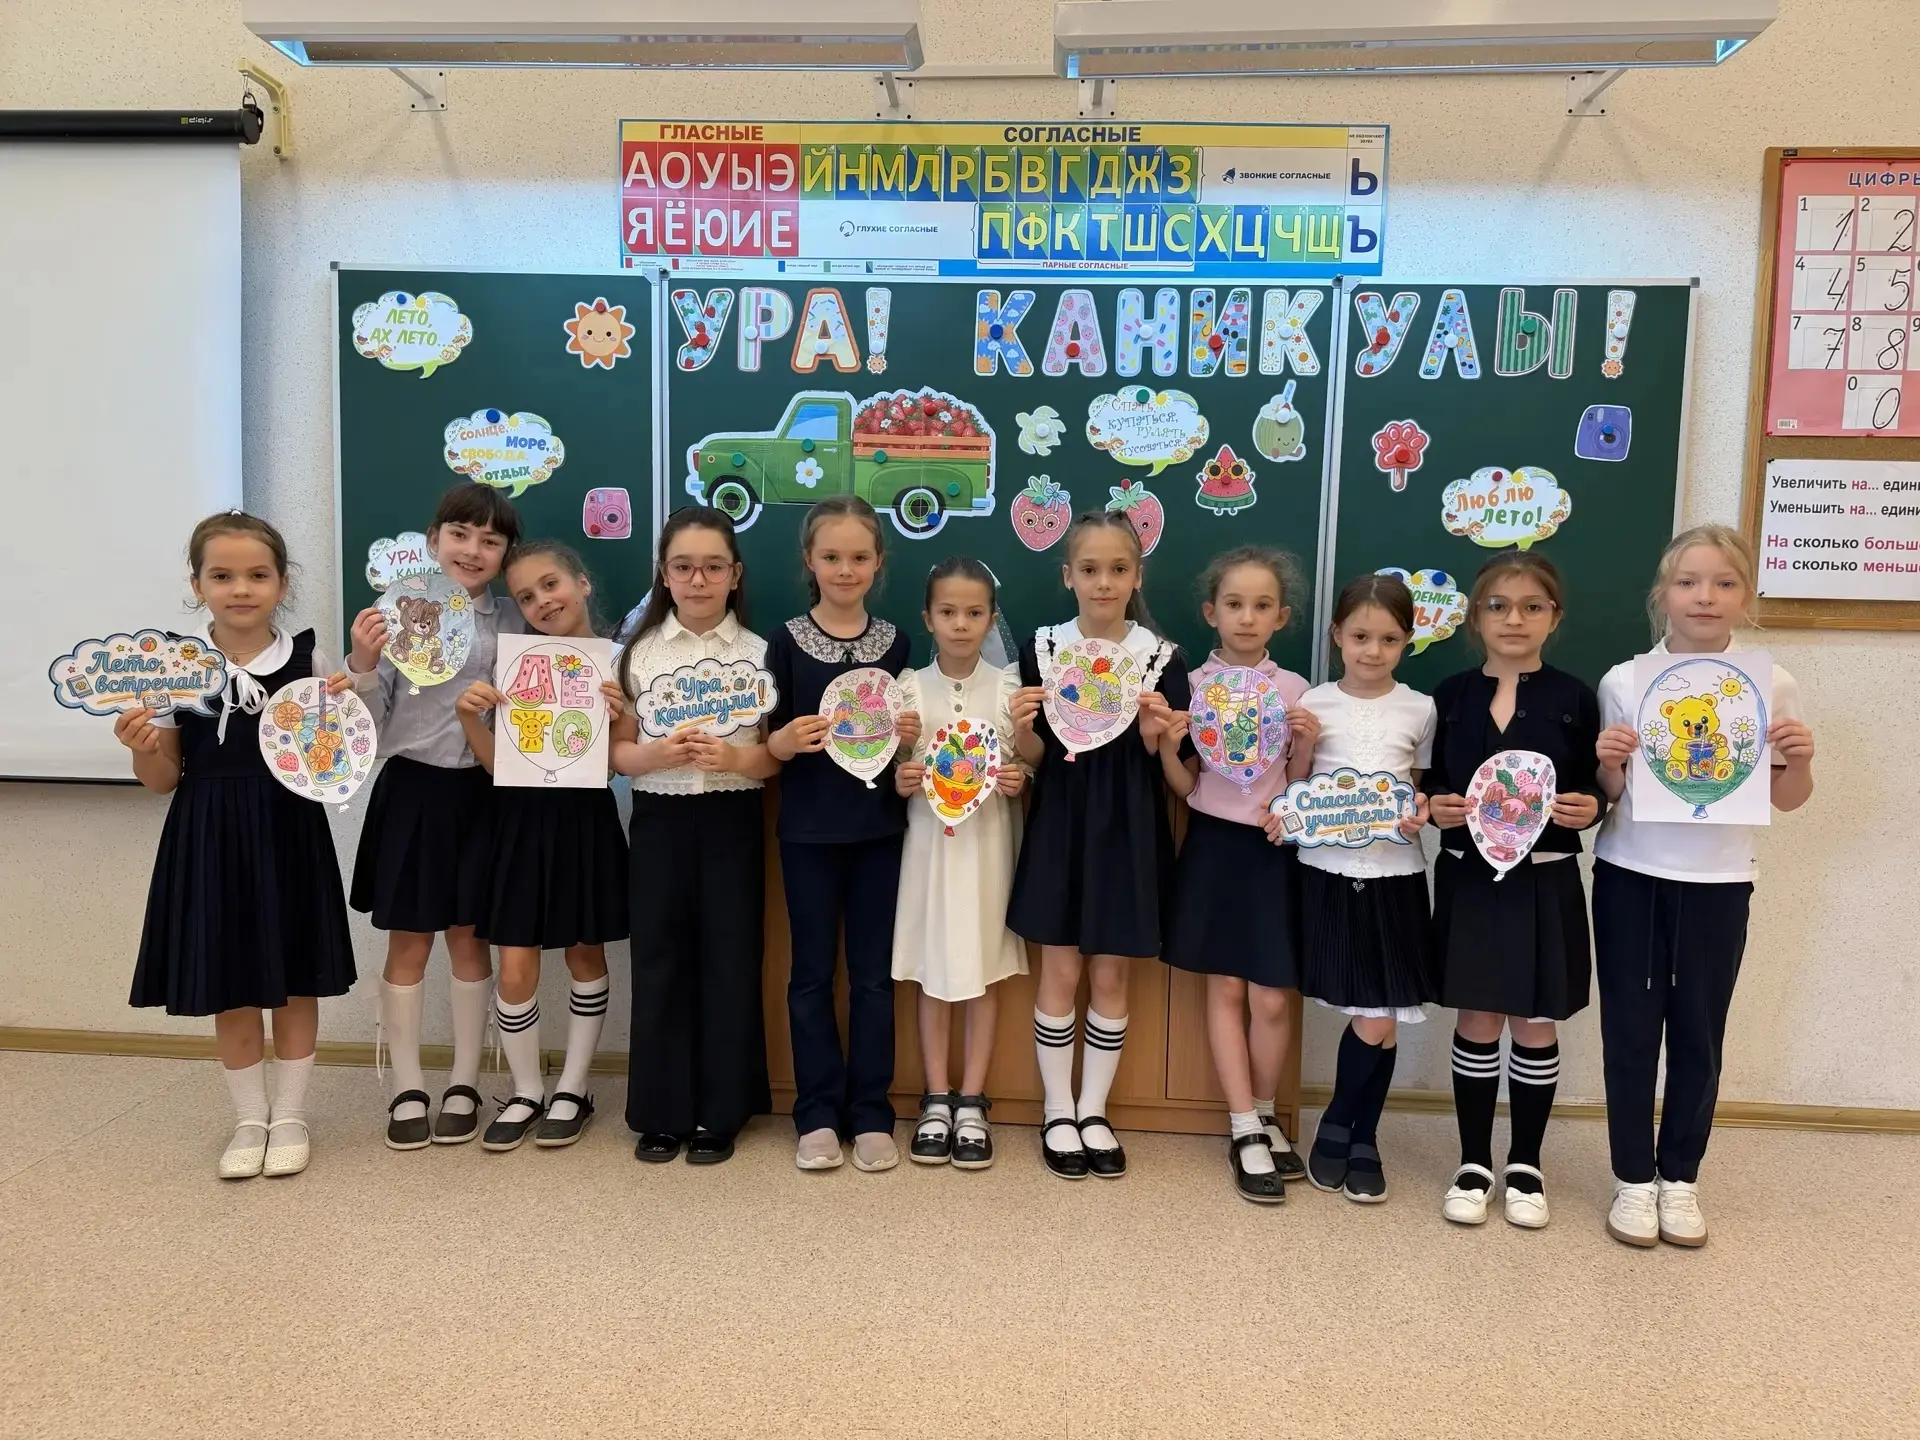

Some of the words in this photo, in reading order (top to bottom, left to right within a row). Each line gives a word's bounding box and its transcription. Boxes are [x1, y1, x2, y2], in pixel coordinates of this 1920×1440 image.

[660, 125, 763, 141] ГЛАСНЫЕ
[1004, 127, 1141, 143] СОГЛАСНЫЕ
[1351, 157, 1378, 195] Ь
[1347, 215, 1378, 254] Ъ
[1800, 197, 1808, 211] 1
[1861, 198, 1870, 211] 2
[1887, 209, 1914, 252] 2
[1796, 257, 1805, 270] 4
[1827, 268, 1850, 311] 4
[1857, 257, 1865, 271] 5
[1885, 269, 1911, 311] 5
[370, 328, 392, 343] АХ
[671, 287, 892, 374] УРА!
[1793, 316, 1801, 330] 7
[1823, 328, 1846, 369] 7
[1852, 317, 1861, 331] 8
[1878, 329, 1905, 370] 8
[1848, 376, 1857, 390] 0
[1772, 475, 1847, 490] Увеличить
[1770, 500, 1845, 514] Уменьшить
[1767, 535, 1788, 548] На
[1793, 538, 1859, 549] сколько
[1864, 537, 1920, 550] больш
[386, 548, 422, 565] УРА!
[1766, 557, 1787, 570] На
[1792, 560, 1857, 571] сколько
[1863, 562, 1920, 573] меньш
[85, 651, 167, 674] Лето,
[95, 670, 213, 699] встречай!
[676, 677, 731, 701] Ура,
[1296, 788, 1384, 811] Спасибо,
